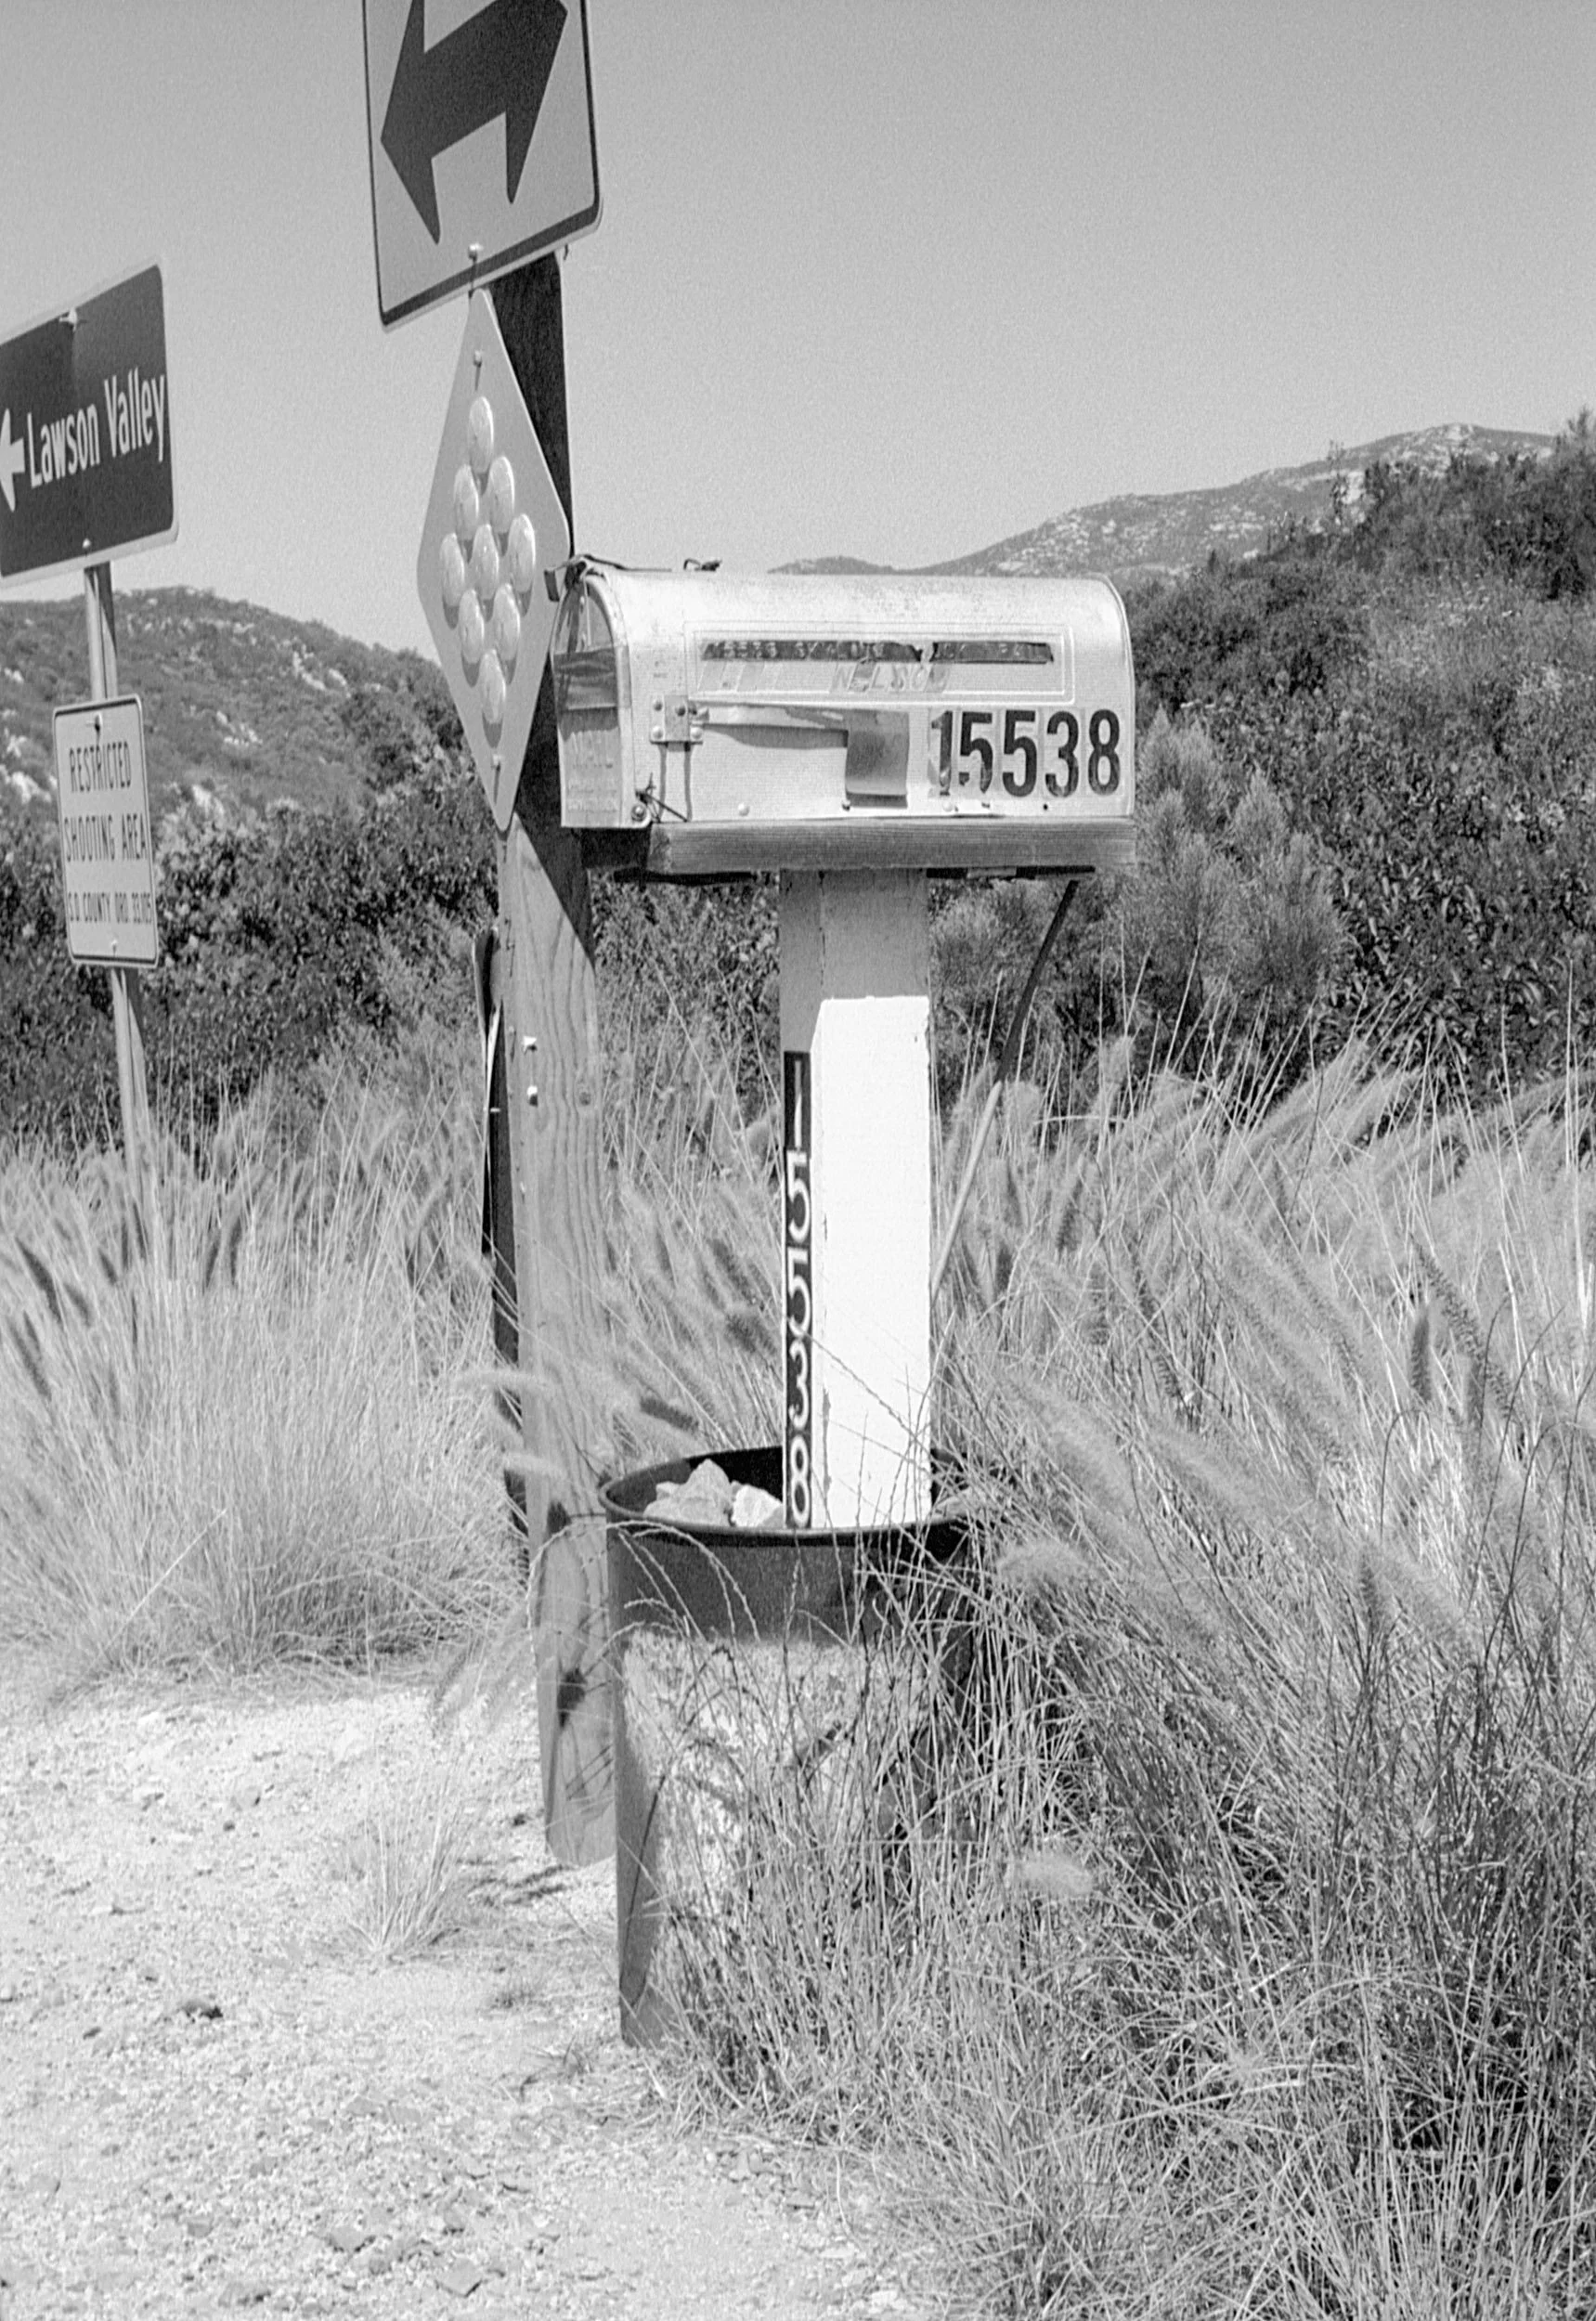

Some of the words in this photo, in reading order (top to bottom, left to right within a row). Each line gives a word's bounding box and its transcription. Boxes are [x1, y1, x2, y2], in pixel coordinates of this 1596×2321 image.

[27, 402, 101, 489] Lawson
[103, 366, 165, 463] Valley
[69, 741, 132, 793] RESTRICTED
[931, 708, 1121, 797] 15538
[64, 813, 116, 862] SHOOTING
[122, 812, 149, 861] AREA
[785, 1059, 811, 1529] 15538
